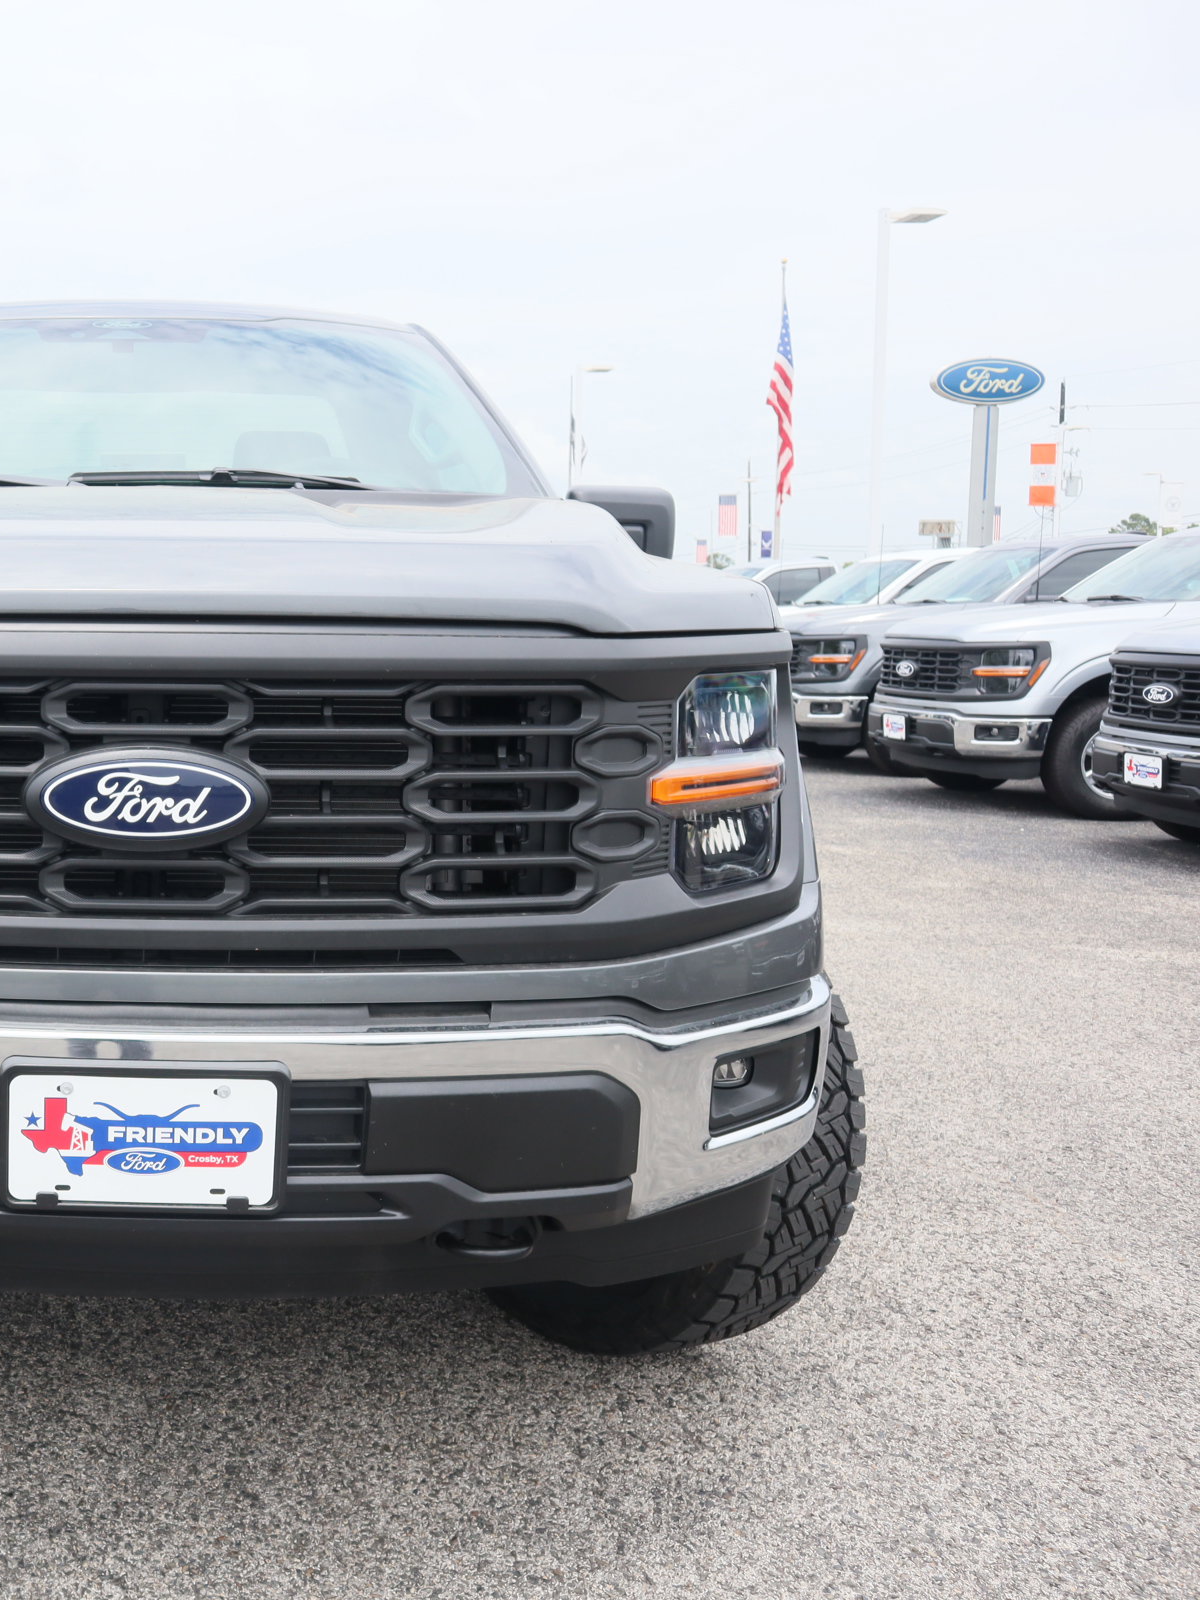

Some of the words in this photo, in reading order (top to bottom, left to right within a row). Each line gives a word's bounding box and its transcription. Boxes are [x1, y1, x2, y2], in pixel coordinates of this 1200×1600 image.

[960, 366, 1025, 394] Ford
[1148, 687, 1168, 701] Ford
[83, 772, 211, 824] Ford
[107, 1125, 250, 1145] FRIENDLY
[120, 1152, 168, 1171] Ford
[187, 1154, 224, 1165] Crosby,
[226, 1155, 239, 1164] TX
